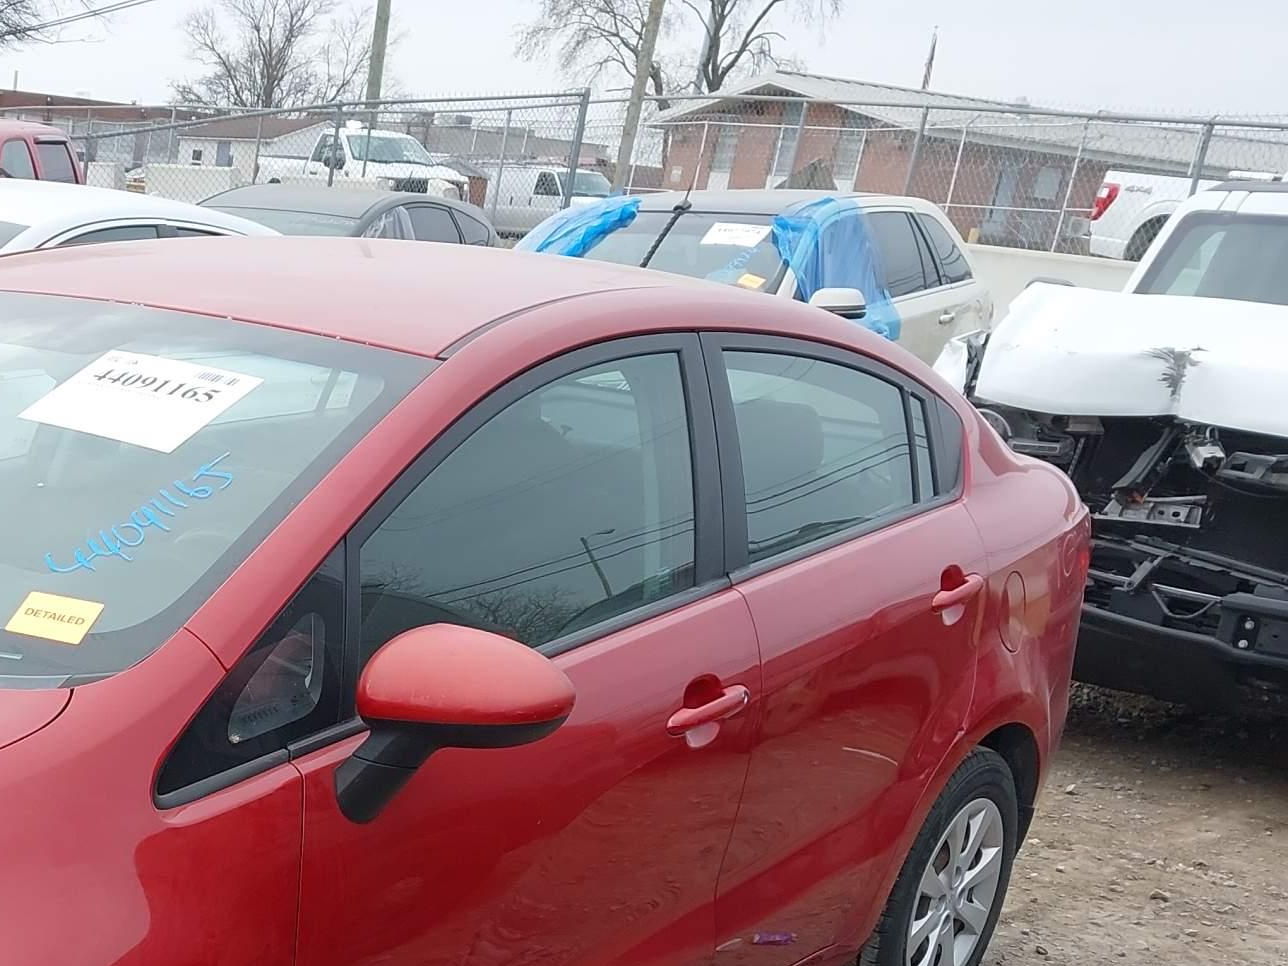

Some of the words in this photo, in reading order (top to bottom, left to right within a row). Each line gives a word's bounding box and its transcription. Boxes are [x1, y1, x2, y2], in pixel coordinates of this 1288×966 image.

[92, 368, 222, 403] 44091165
[43, 451, 234, 574] 44091165
[23, 606, 86, 627] DETAILED
